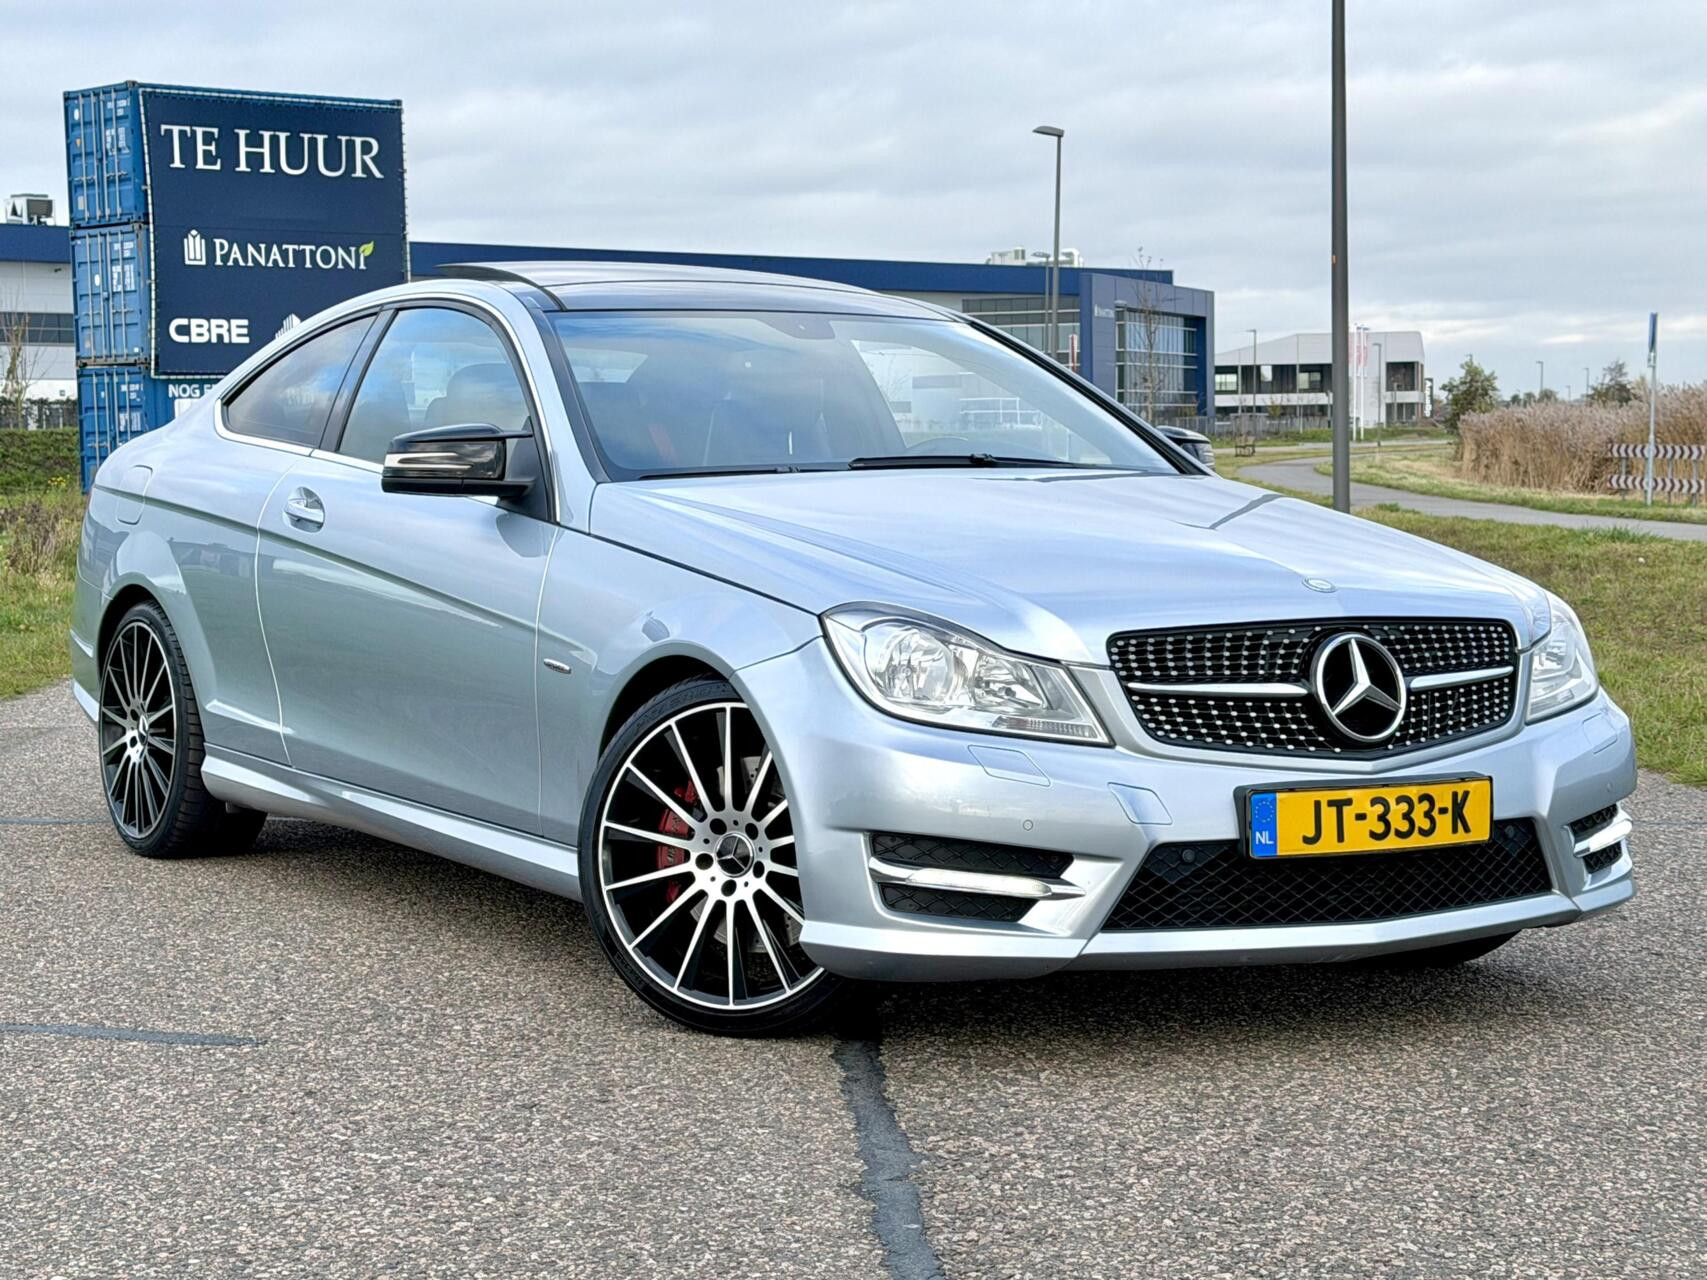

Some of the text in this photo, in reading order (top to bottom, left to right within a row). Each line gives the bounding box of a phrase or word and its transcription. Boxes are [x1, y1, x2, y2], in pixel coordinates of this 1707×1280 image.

[160, 124, 222, 171] TE
[235, 129, 385, 179] HUUR
[168, 318, 250, 344] CBRE
[168, 384, 201, 398] NOG
[1255, 790, 1472, 845] NL JT-333-K
